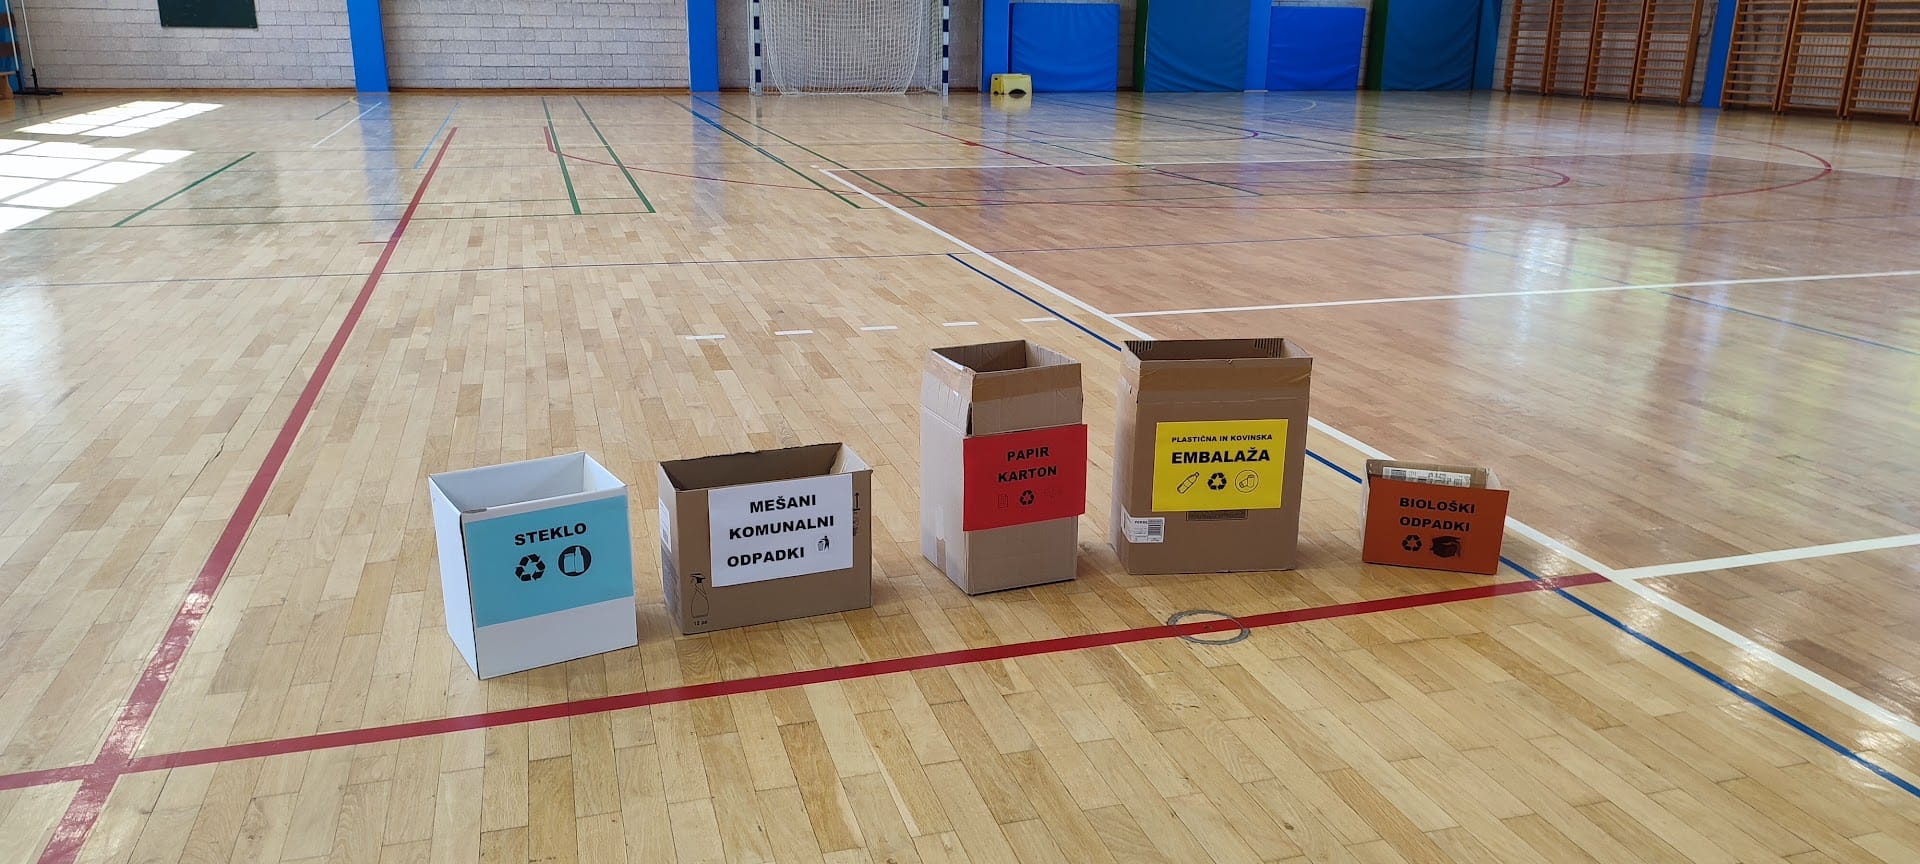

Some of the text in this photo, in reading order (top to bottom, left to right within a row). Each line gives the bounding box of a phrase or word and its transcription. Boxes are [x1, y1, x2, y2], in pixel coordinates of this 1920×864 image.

[1171, 435, 1217, 443] PLASTIČNA
[1007, 446, 1050, 462] PAPIR
[1171, 446, 1270, 464] EMBALAŽA
[998, 465, 1057, 483] KARTON
[749, 494, 817, 514] MEŠANI
[1399, 497, 1475, 514] BIOLOŠKI
[728, 515, 835, 540] KOMUNALNI
[1399, 516, 1470, 532] ODPADKI
[514, 522, 587, 546] STEKLO
[726, 546, 805, 568] ODPADKI
